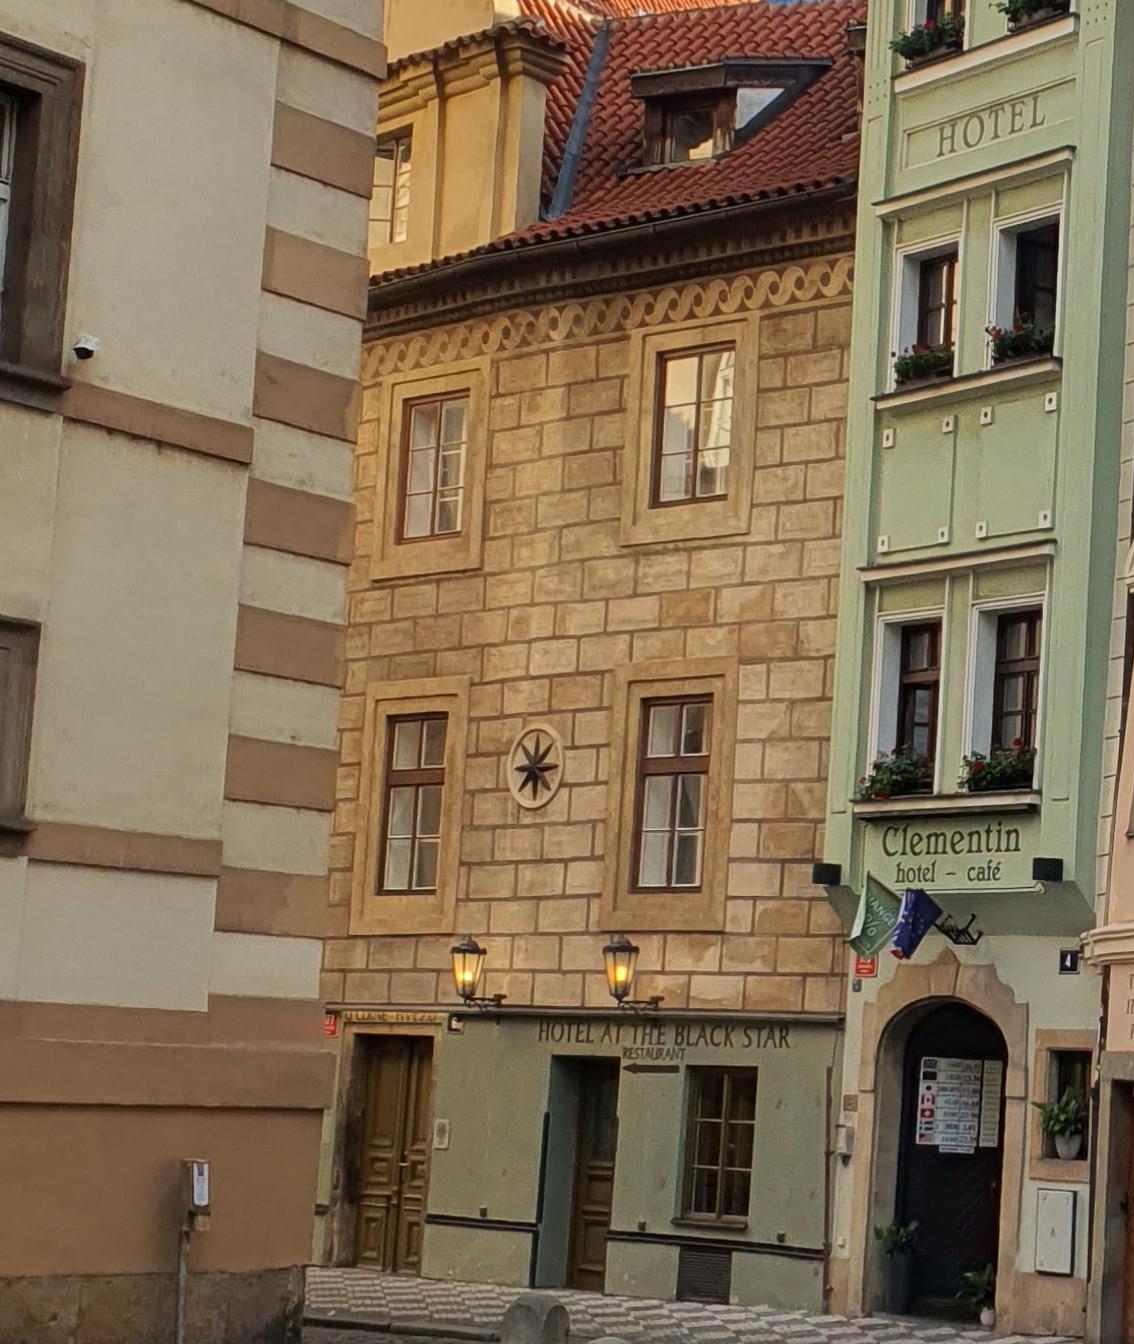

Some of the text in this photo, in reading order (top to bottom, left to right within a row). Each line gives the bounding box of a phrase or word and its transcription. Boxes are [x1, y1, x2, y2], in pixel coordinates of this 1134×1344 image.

[936, 94, 1046, 158] HOTEL
[881, 820, 1022, 857] Clementin
[894, 859, 937, 884] hotel
[966, 858, 1002, 882] café
[538, 1018, 791, 1049] HOTEL AT THE BLACK STAR
[622, 1046, 687, 1062] RESTAURANT
